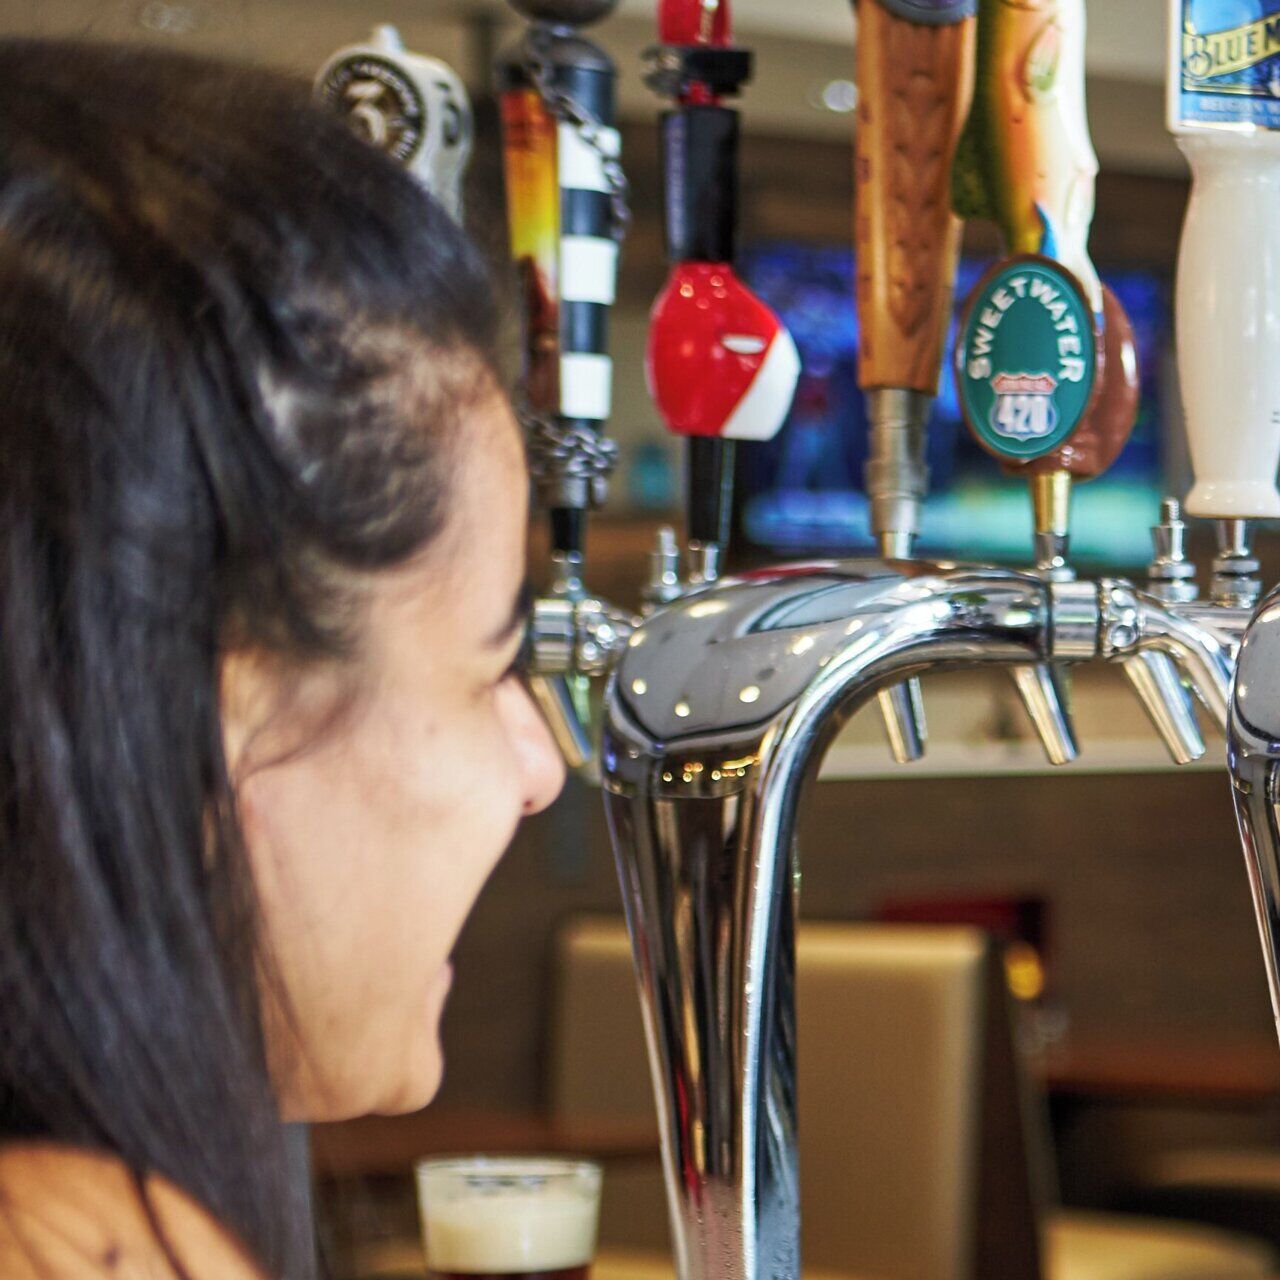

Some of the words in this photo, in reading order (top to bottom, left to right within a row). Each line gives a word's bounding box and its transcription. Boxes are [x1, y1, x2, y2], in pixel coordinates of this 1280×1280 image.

[1184, 30, 1258, 81] BLUE
[967, 276, 1086, 383] SWEETWATER
[997, 395, 1050, 434] 420
